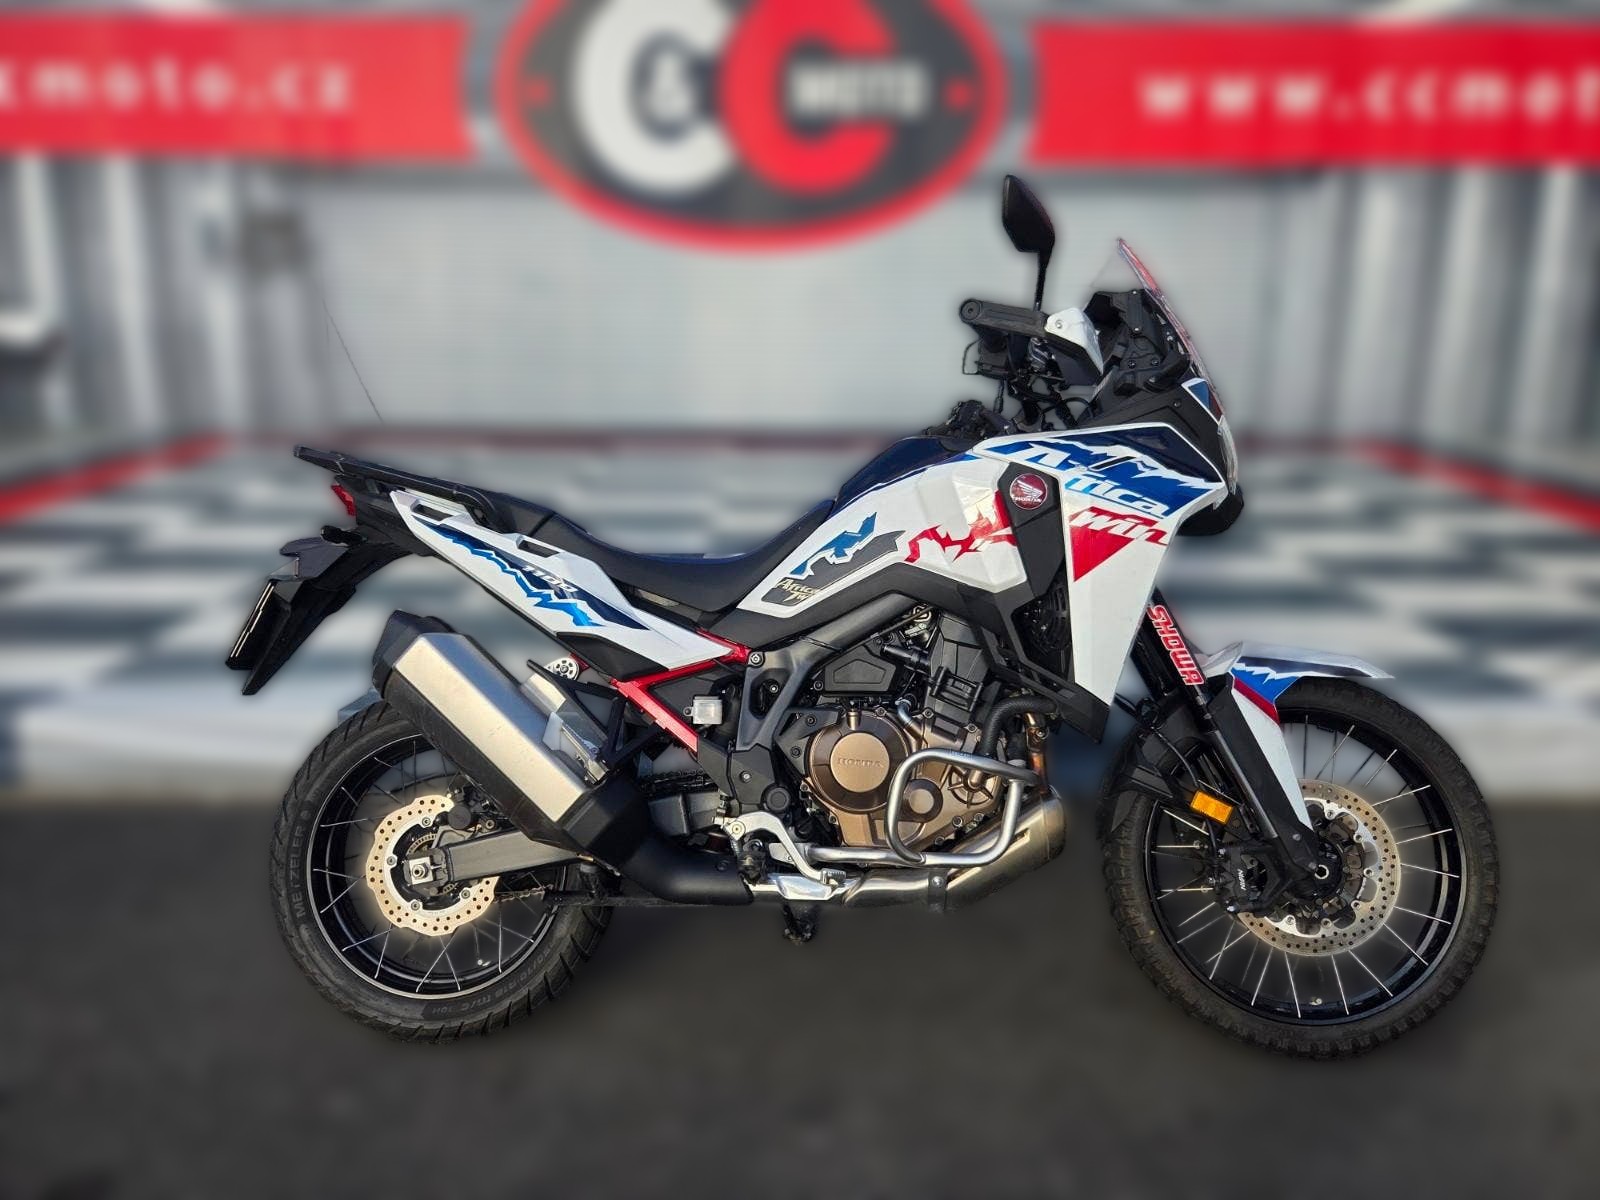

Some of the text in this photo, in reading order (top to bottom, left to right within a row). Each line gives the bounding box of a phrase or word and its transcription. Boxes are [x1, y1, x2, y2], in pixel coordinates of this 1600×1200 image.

[1147, 604, 1206, 686] SHOWA
[838, 757, 884, 769] HONDA
[289, 825, 307, 918] METZELER
